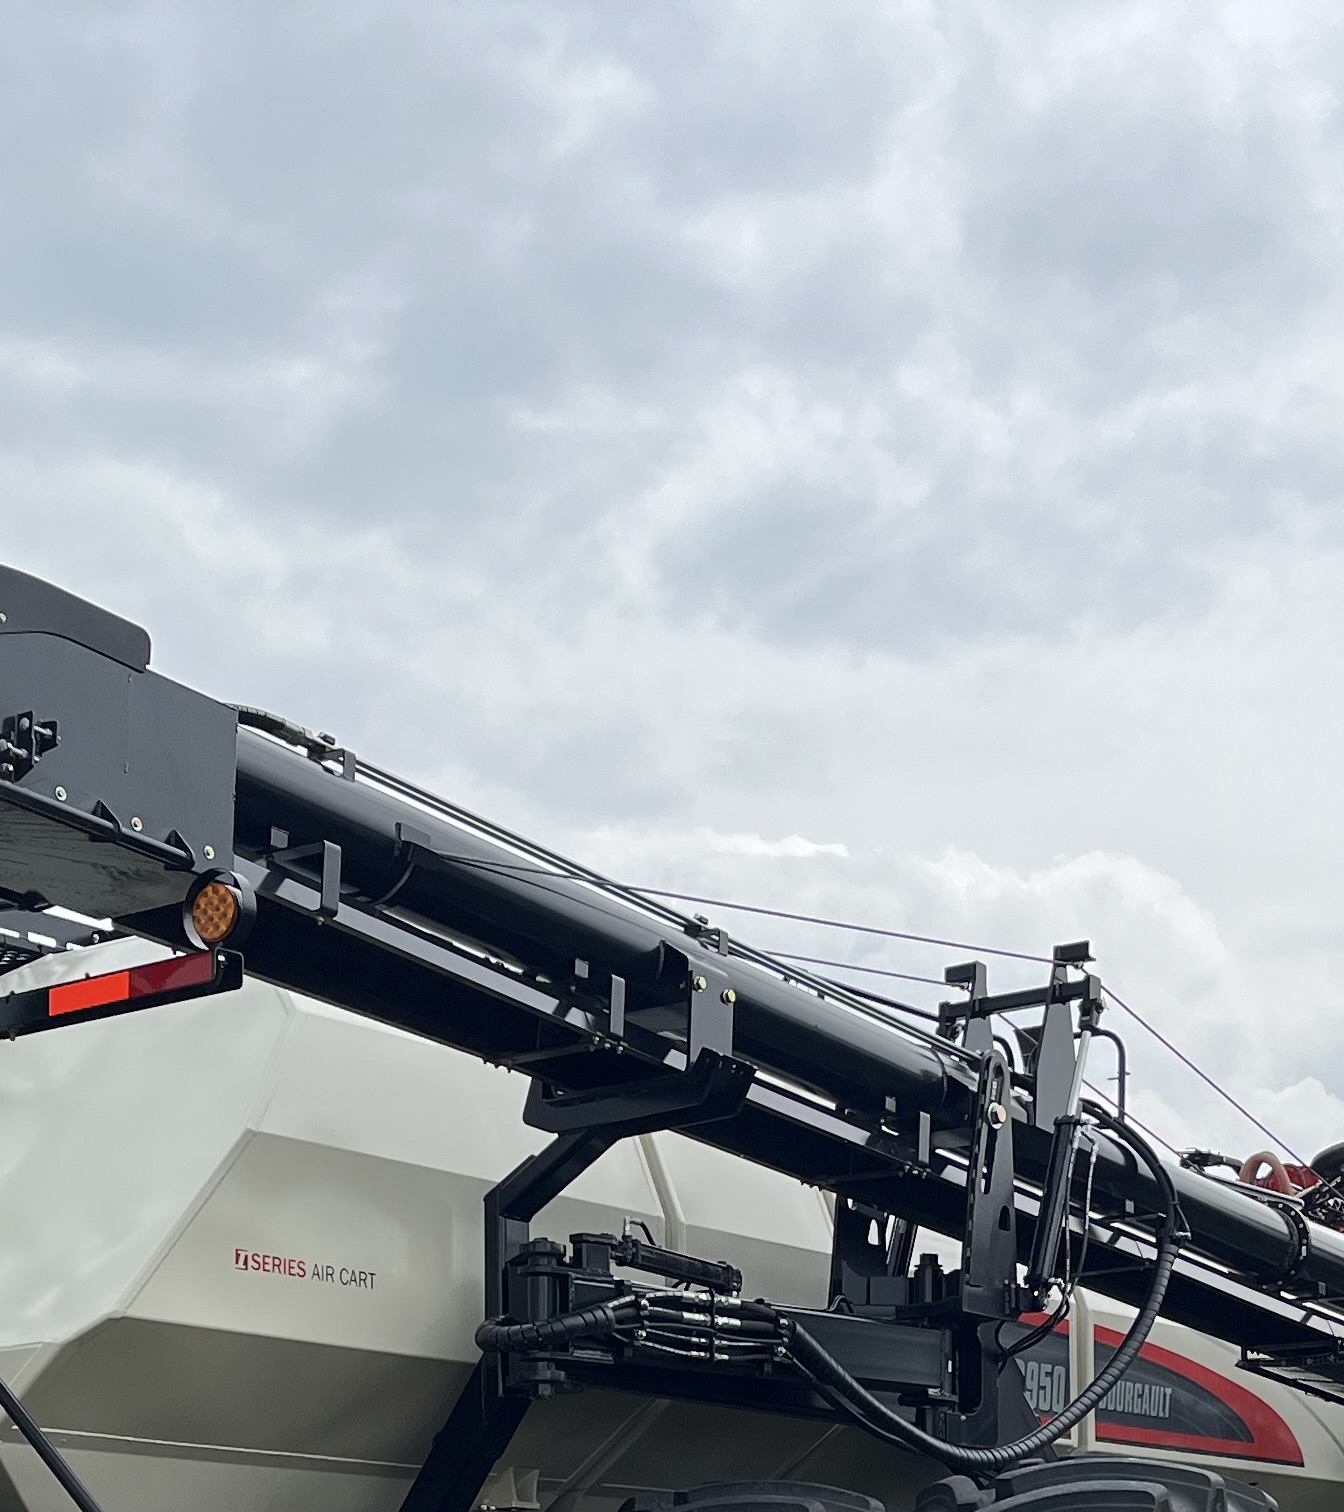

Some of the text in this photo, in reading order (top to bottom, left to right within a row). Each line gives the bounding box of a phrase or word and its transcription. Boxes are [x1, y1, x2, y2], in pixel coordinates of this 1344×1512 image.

[311, 1263, 336, 1283] AIR
[339, 1267, 377, 1290] CART
[1015, 1358, 1066, 1414] 950
[1098, 1379, 1173, 1419] OURGAULT
